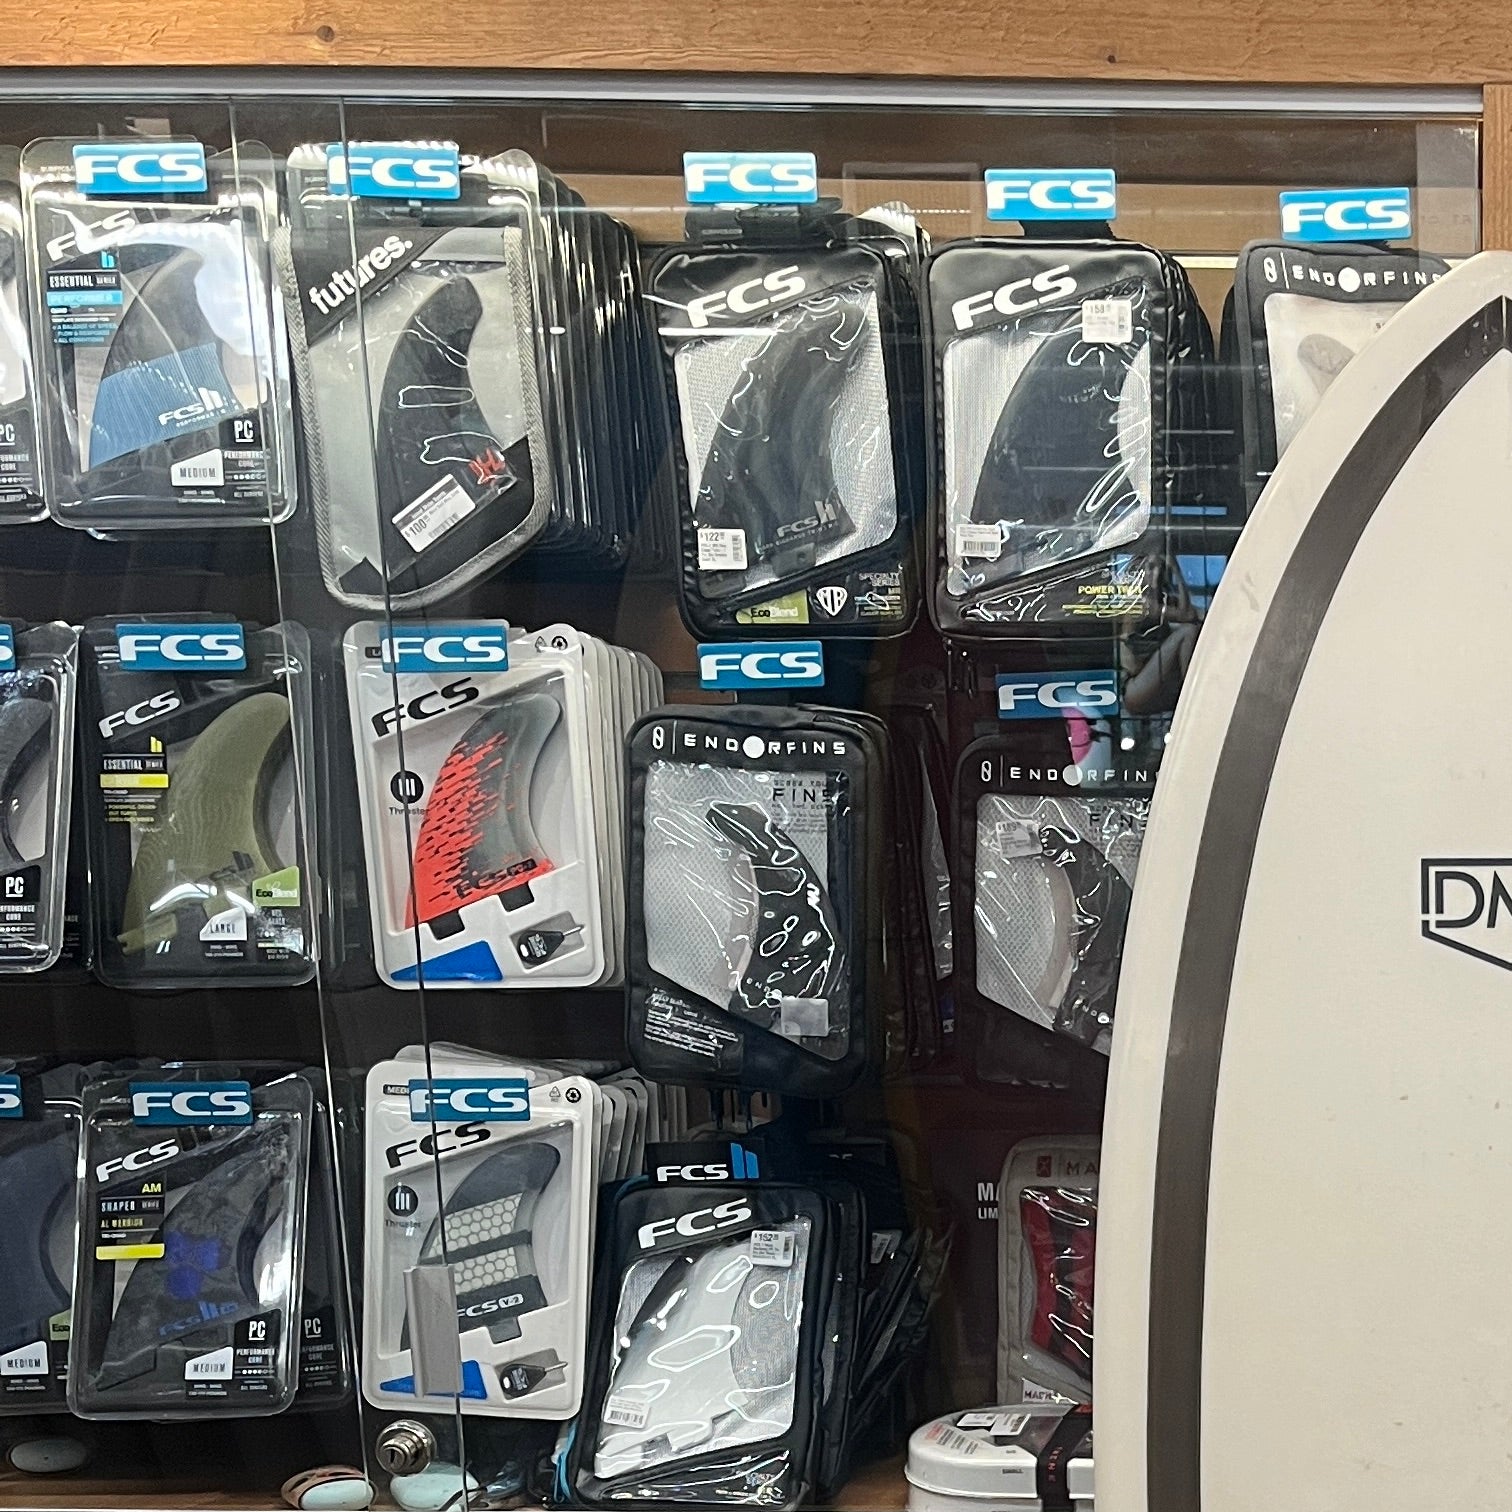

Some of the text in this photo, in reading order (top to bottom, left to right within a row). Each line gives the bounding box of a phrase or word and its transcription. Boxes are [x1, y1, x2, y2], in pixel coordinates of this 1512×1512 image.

[75, 154, 203, 184] FCS
[329, 155, 458, 187] FCS
[686, 163, 817, 193] FCS
[986, 180, 1116, 209] FCS
[1282, 199, 1409, 232] FCS
[47, 209, 136, 262] FCS
[49, 274, 94, 287] ESSENTIAL
[687, 265, 806, 328] FCS
[951, 264, 1077, 331] FCS
[158, 402, 205, 427] FCS
[234, 421, 254, 440] PC
[180, 467, 216, 478] MEDIUM
[776, 516, 819, 538] FCS
[118, 634, 244, 662] FCS
[381, 636, 506, 663] FCS
[701, 652, 822, 680] FCS
[371, 676, 479, 737] FCS
[998, 680, 1117, 710] FCS
[99, 690, 181, 738] FCS
[103, 759, 143, 771] ESSENTIAL
[5, 876, 24, 894] PC
[210, 922, 236, 934] LARGE
[132, 1091, 250, 1117] FCS
[410, 1087, 528, 1113] FCS
[385, 1120, 491, 1168] FCS
[96, 1139, 180, 1183] FCS
[656, 1164, 729, 1182] FCS
[141, 1183, 161, 1193] AM
[638, 1197, 752, 1249] FCS
[249, 1321, 265, 1337] PC
[304, 1318, 321, 1335] PC
[7, 1358, 41, 1368] MEDIUM
[193, 1362, 226, 1373] MEDIUM
